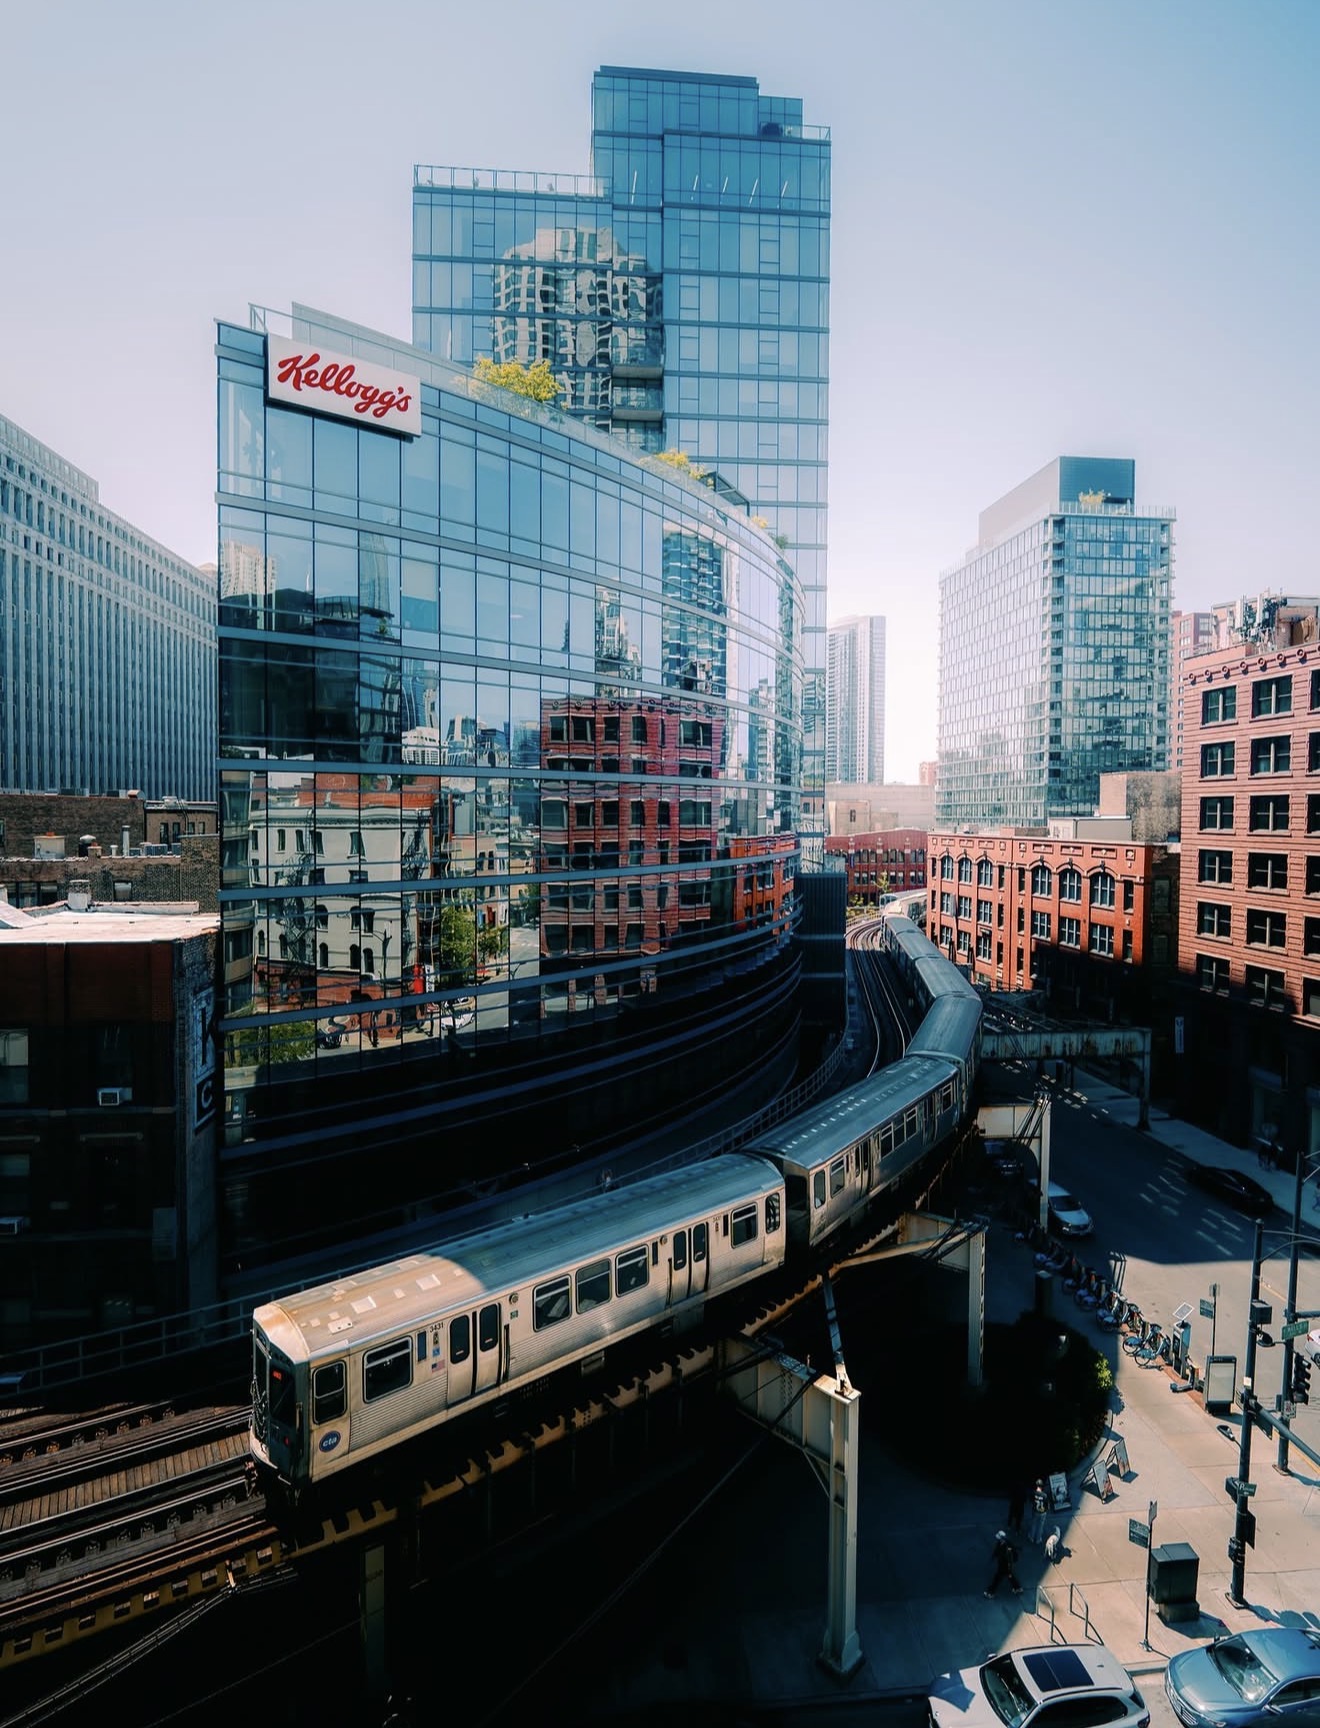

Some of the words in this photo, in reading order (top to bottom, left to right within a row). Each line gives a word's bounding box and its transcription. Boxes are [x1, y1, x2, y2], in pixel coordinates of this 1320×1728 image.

[277, 353, 412, 418] Kellogg's
[429, 1322, 444, 1333] 3431
[322, 1436, 337, 1447] cta
